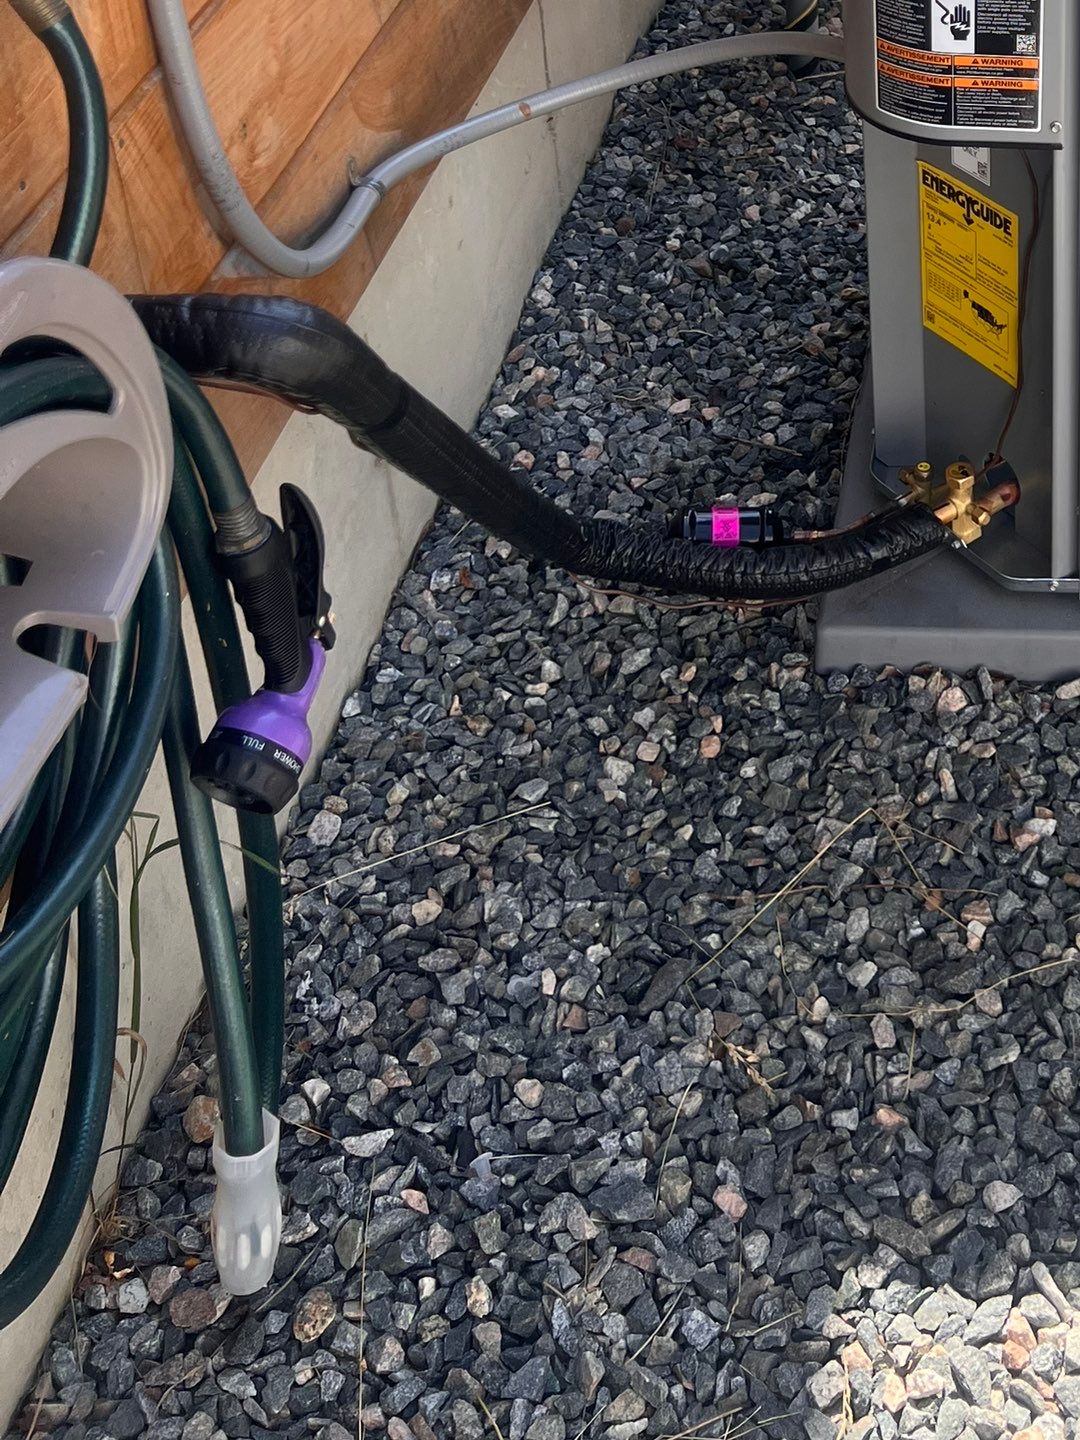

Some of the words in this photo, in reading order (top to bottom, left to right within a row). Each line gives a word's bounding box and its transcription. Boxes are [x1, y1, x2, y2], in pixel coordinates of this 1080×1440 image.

[887, 44, 950, 63] AVERTISSEMENT
[886, 66, 950, 85] AVERTISSEMENT
[981, 80, 1023, 88] WARNING
[922, 169, 1012, 237] ENERGYGUIDE
[242, 735, 266, 751] FULL
[273, 748, 302, 775] SHOWER
